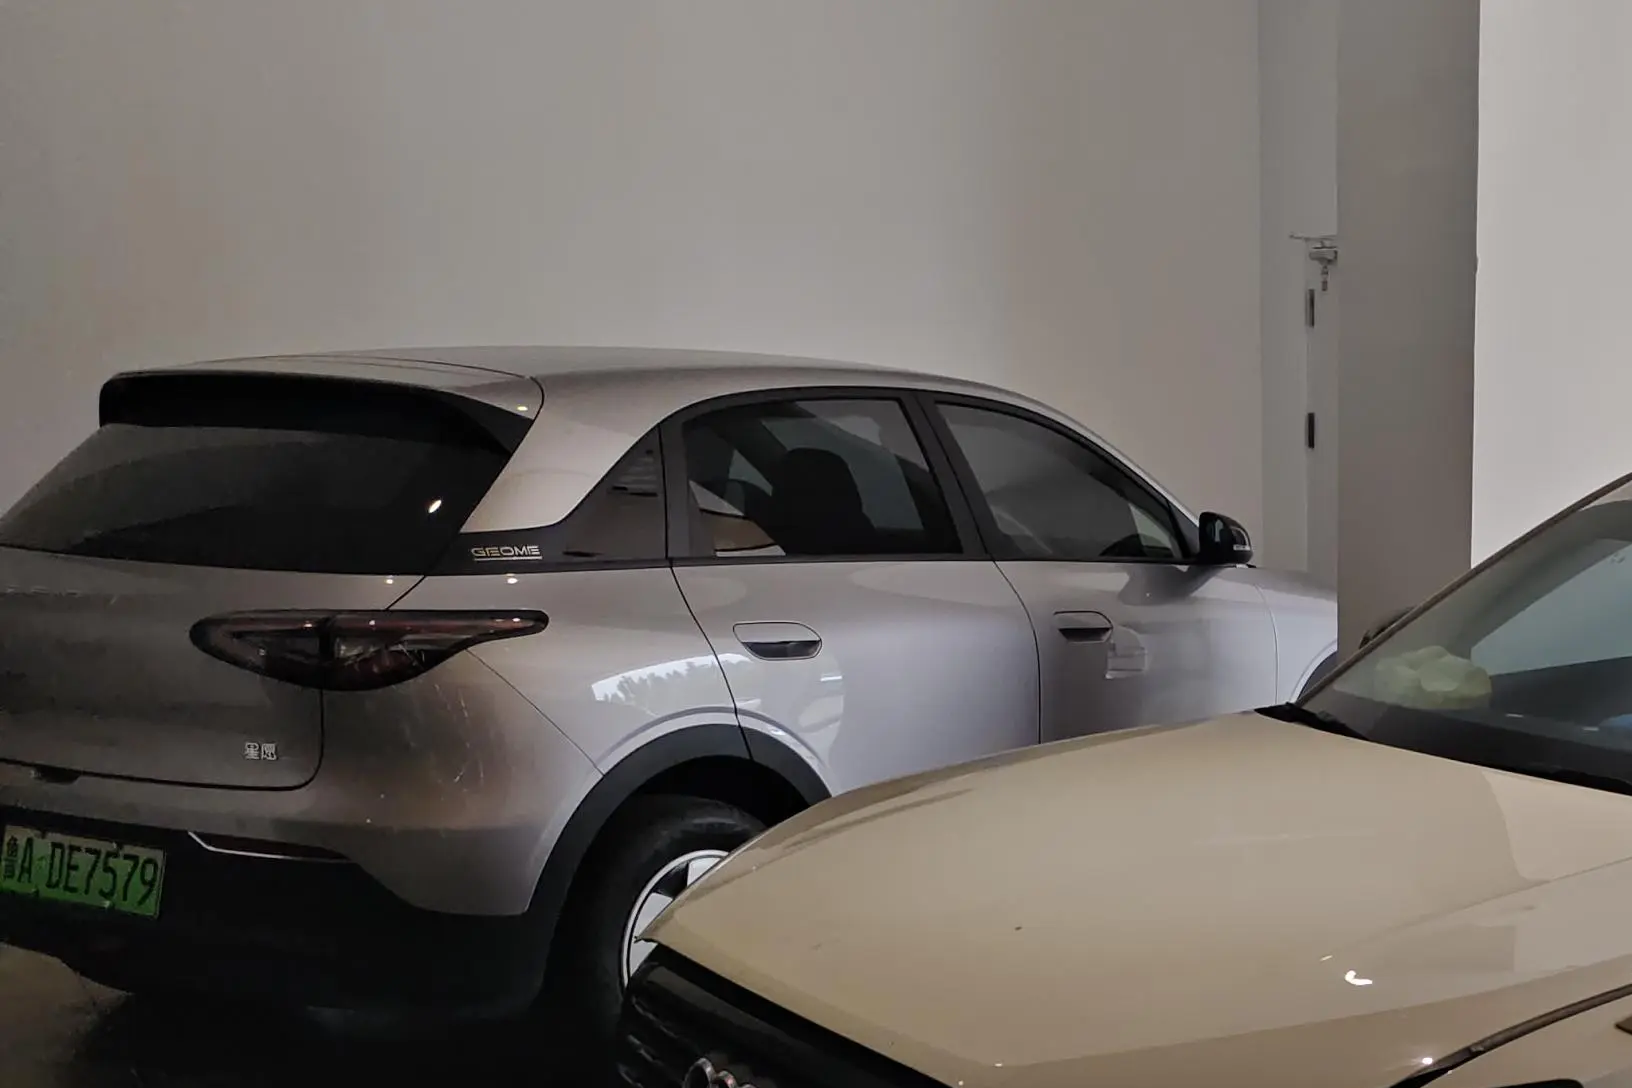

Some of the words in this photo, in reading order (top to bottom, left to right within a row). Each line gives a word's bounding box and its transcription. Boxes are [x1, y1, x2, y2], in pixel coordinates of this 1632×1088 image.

[470, 545, 541, 557] GEOME
[243, 742, 277, 761] 星愿
[45, 841, 158, 907] DE7579
